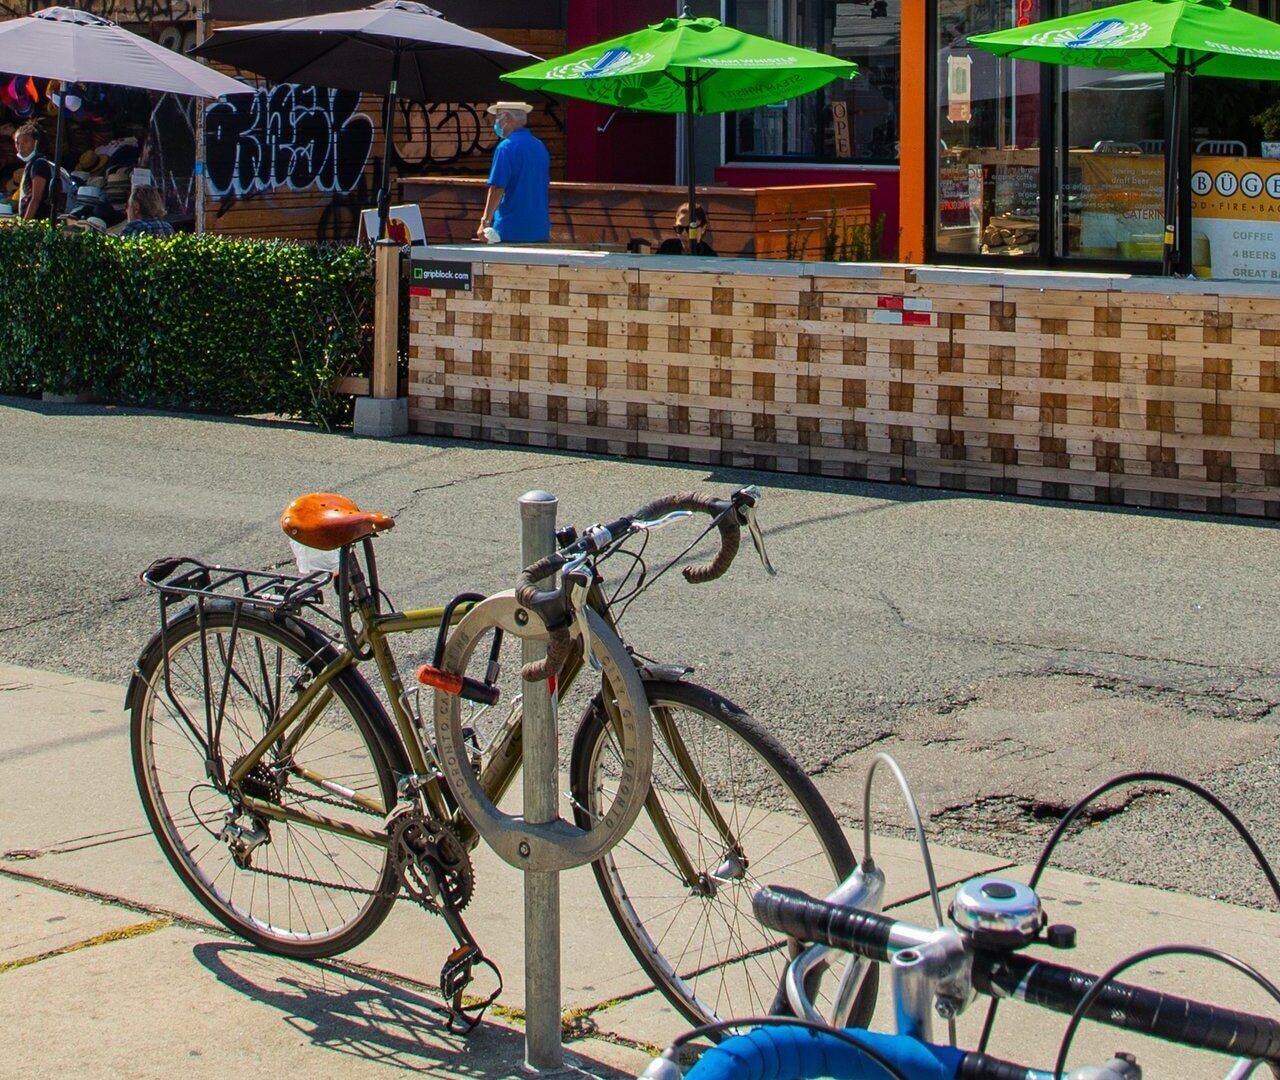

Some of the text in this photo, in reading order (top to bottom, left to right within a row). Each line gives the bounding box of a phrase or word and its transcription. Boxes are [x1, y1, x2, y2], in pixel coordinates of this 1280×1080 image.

[832, 103, 849, 154] OPE
[1219, 202, 1247, 212] FIRE
[1122, 209, 1166, 220] CATERIN
[1233, 231, 1273, 241] COFFEE
[1233, 250, 1239, 259] 4
[1242, 250, 1277, 261] BEERS
[423, 269, 470, 281] gripblock.com
[1232, 267, 1268, 278] GREAT
